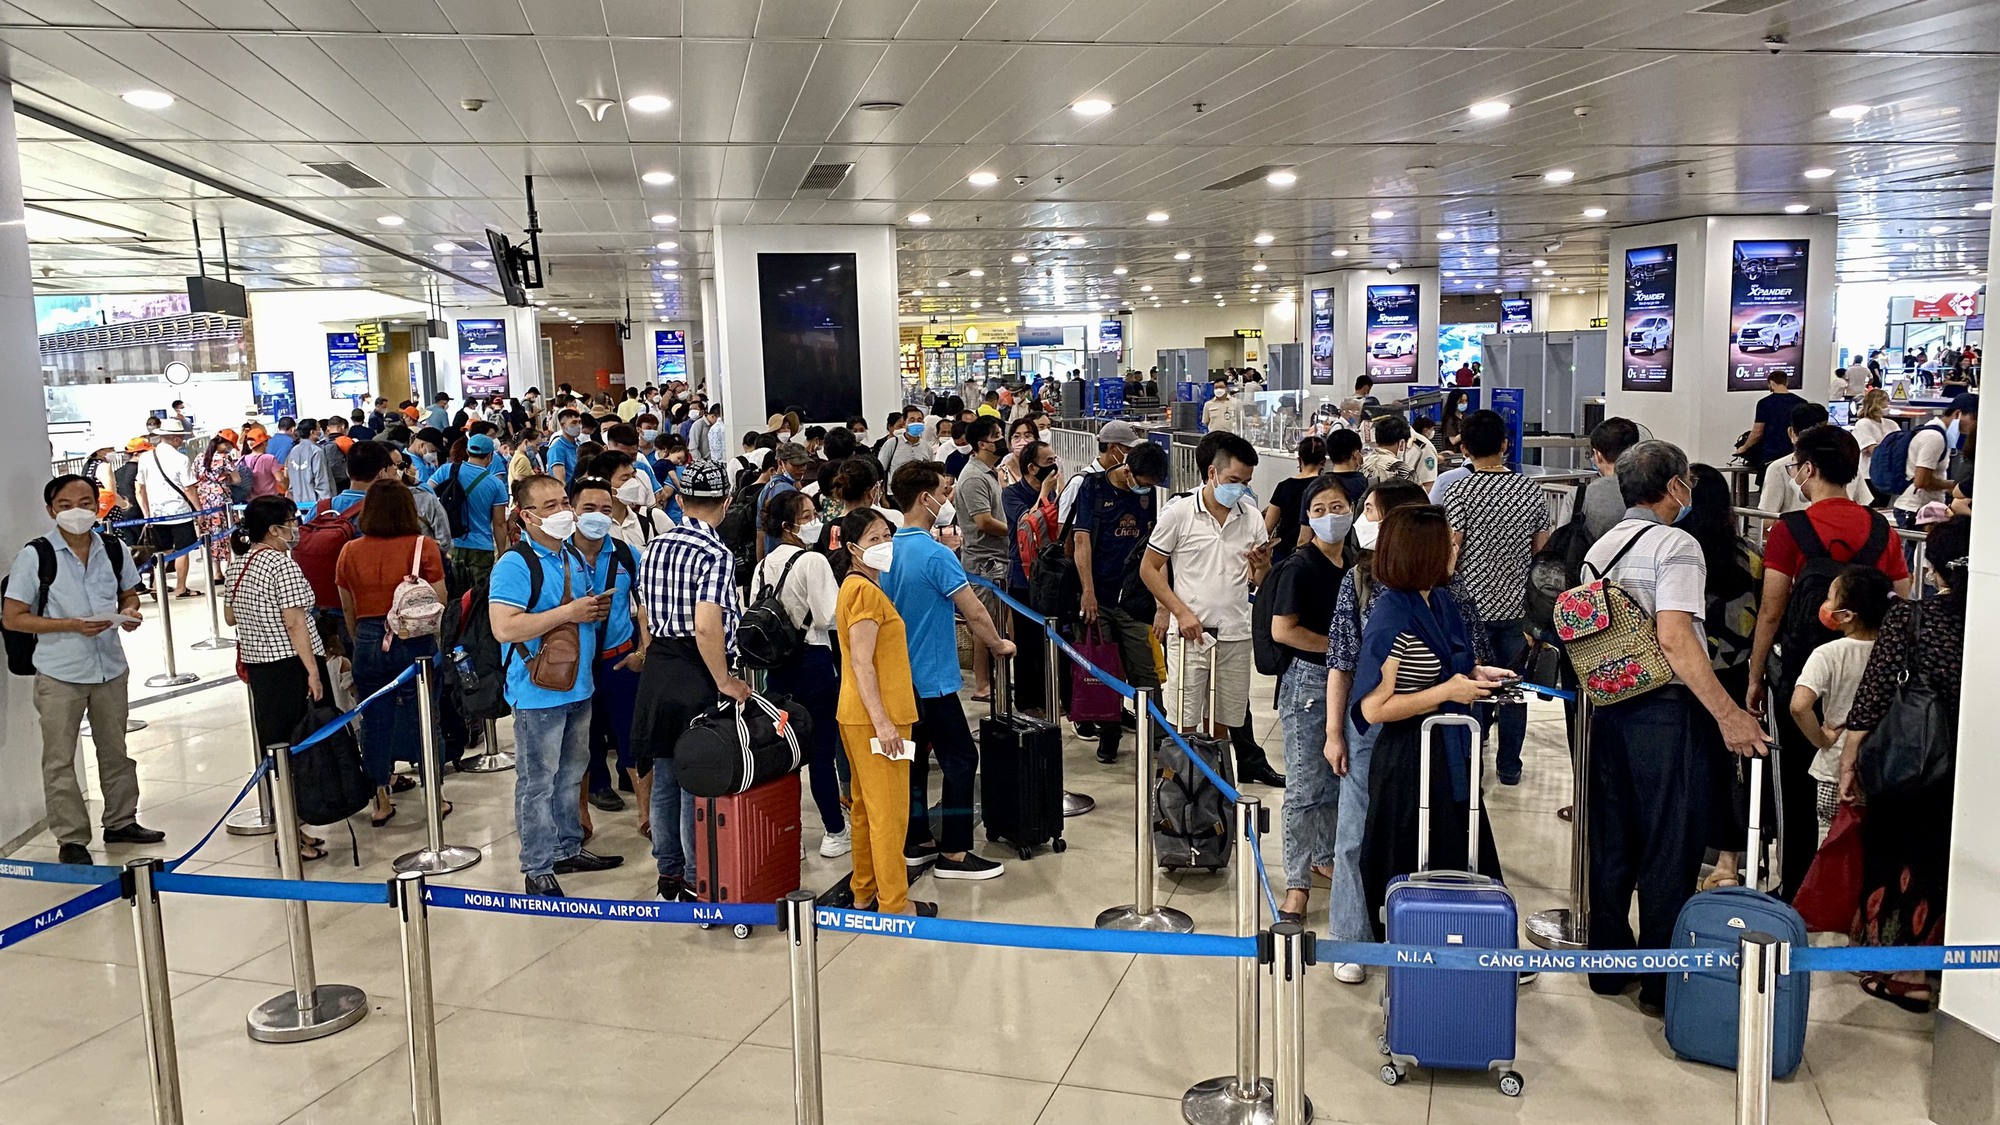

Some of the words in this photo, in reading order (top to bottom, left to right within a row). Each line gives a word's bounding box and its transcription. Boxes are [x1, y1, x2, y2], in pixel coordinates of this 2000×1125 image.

[1634, 293, 1666, 302] XPANDER
[1747, 287, 1792, 296] XPANDER
[1628, 368, 1636, 378] 0%
[1736, 366, 1750, 378] 0%
[0, 864, 34, 876] SECURITY
[464, 894, 504, 908] NOIBAI
[510, 898, 602, 915] INTERNATIONAL
[608, 905, 660, 918] AIRPORT
[694, 908, 723, 920] N.I.A
[35, 908, 64, 928] N.I.A
[844, 915, 916, 934] SECURITY
[1396, 950, 1434, 964] N.I.A
[1479, 951, 1524, 967] CẢNG
[1581, 955, 1638, 968] KHÔNG
[1642, 952, 1689, 968] QUỐC
[1694, 951, 1714, 966] TẾ
[1944, 950, 1966, 964] AN
[1970, 950, 2000, 964] NIN
